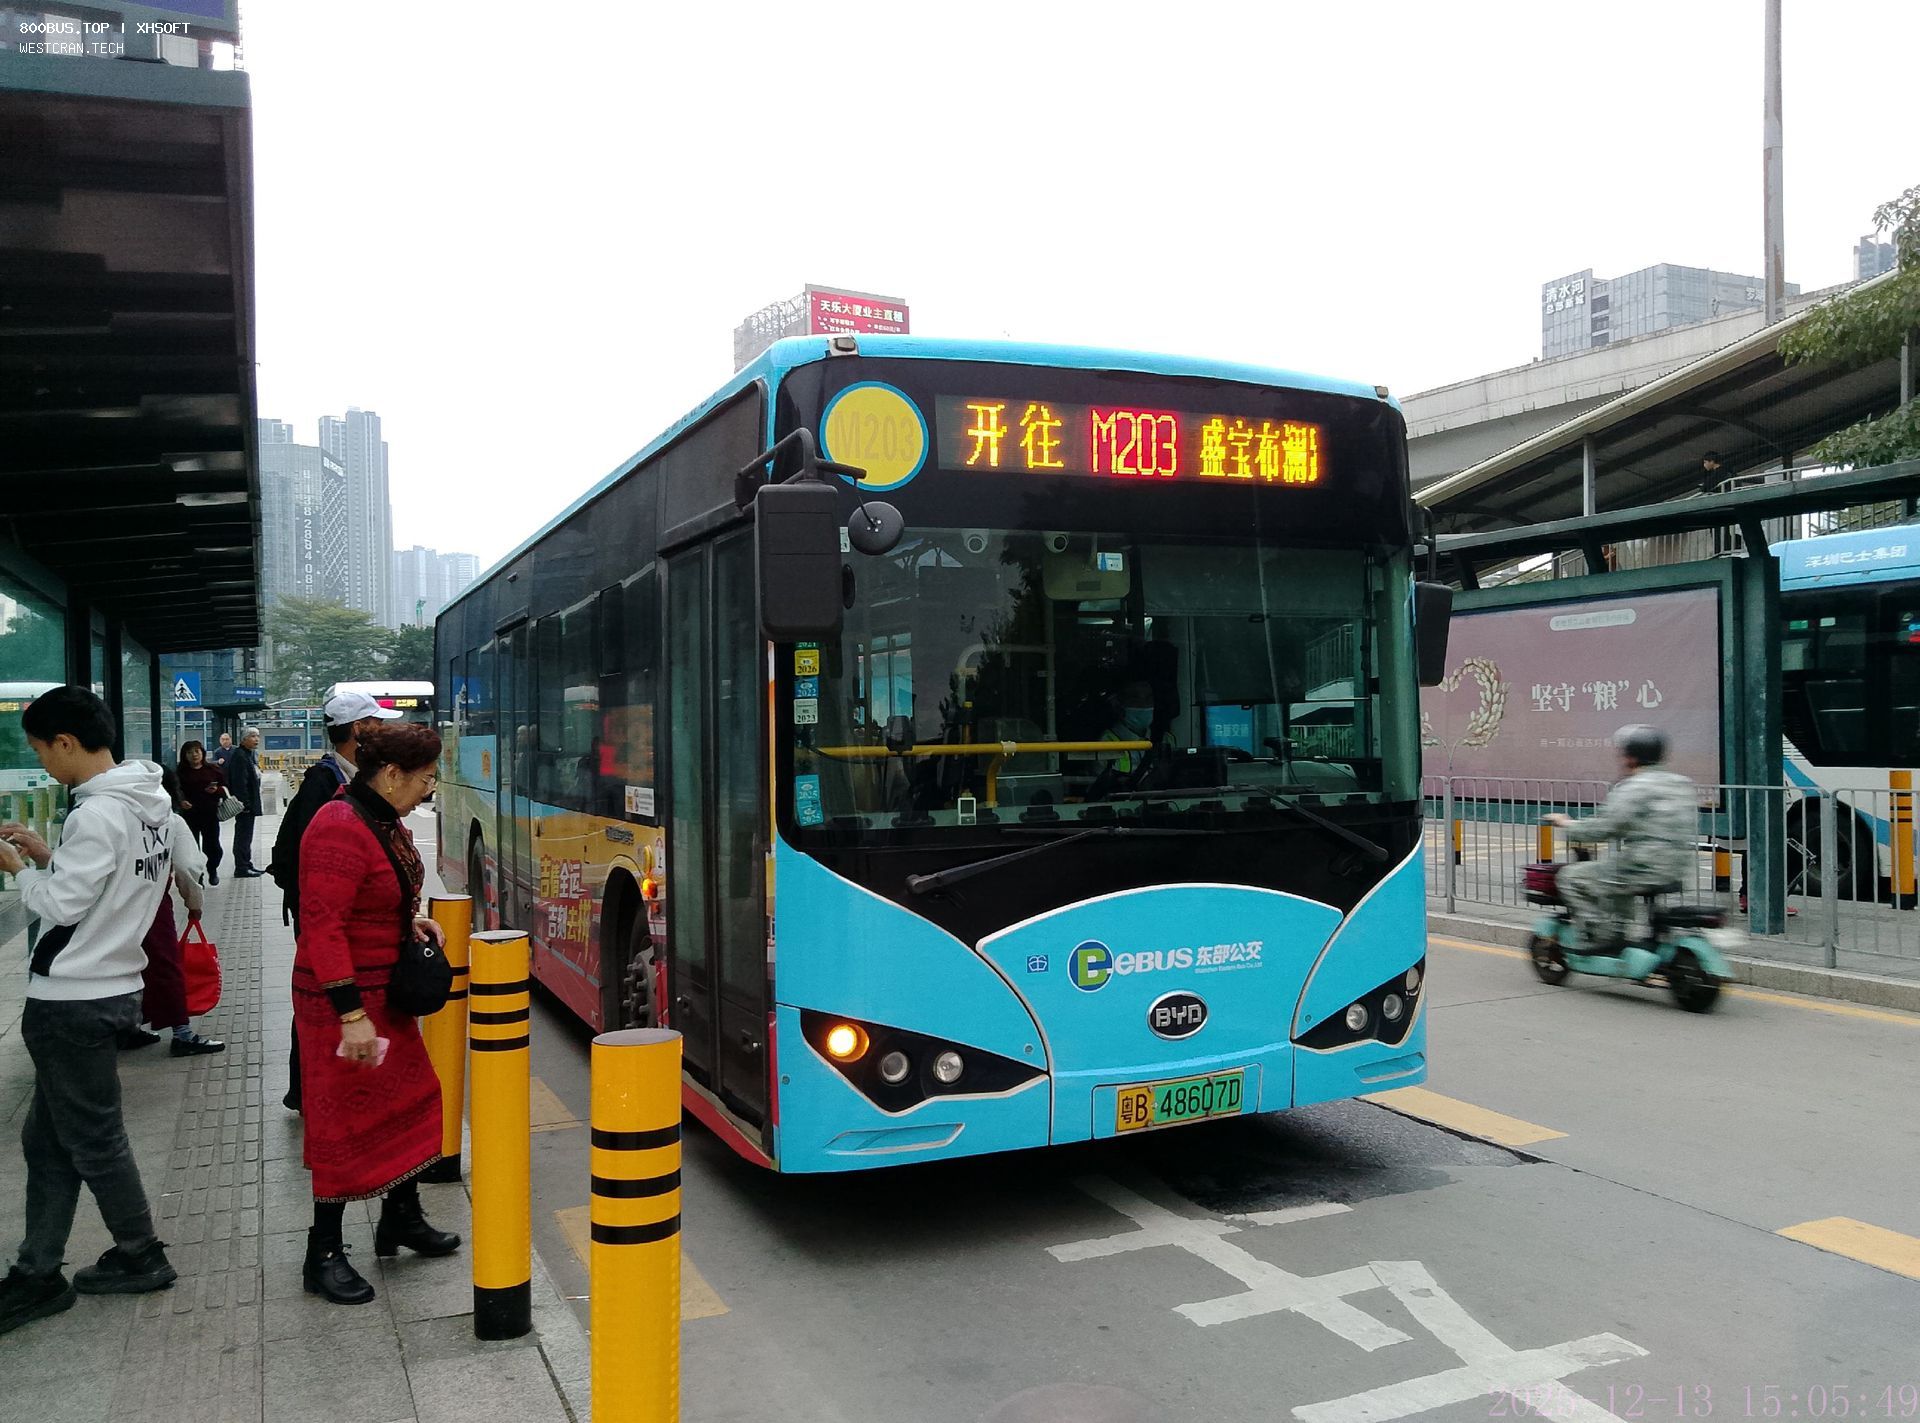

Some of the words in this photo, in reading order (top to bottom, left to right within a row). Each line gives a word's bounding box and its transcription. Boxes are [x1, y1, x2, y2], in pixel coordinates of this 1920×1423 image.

[820, 300, 904, 322] 天乐大厦业主直租
[834, 410, 916, 462] M203
[967, 403, 1065, 468] 开往
[1091, 409, 1177, 476] M203
[1805, 544, 1908, 568] 深圳巴士集团
[797, 666, 817, 674] 2026
[797, 715, 817, 723] 2023
[1196, 941, 1263, 966] 东部公交
[1156, 1004, 1202, 1027] BYD
[1160, 1078, 1240, 1118] 48607D
